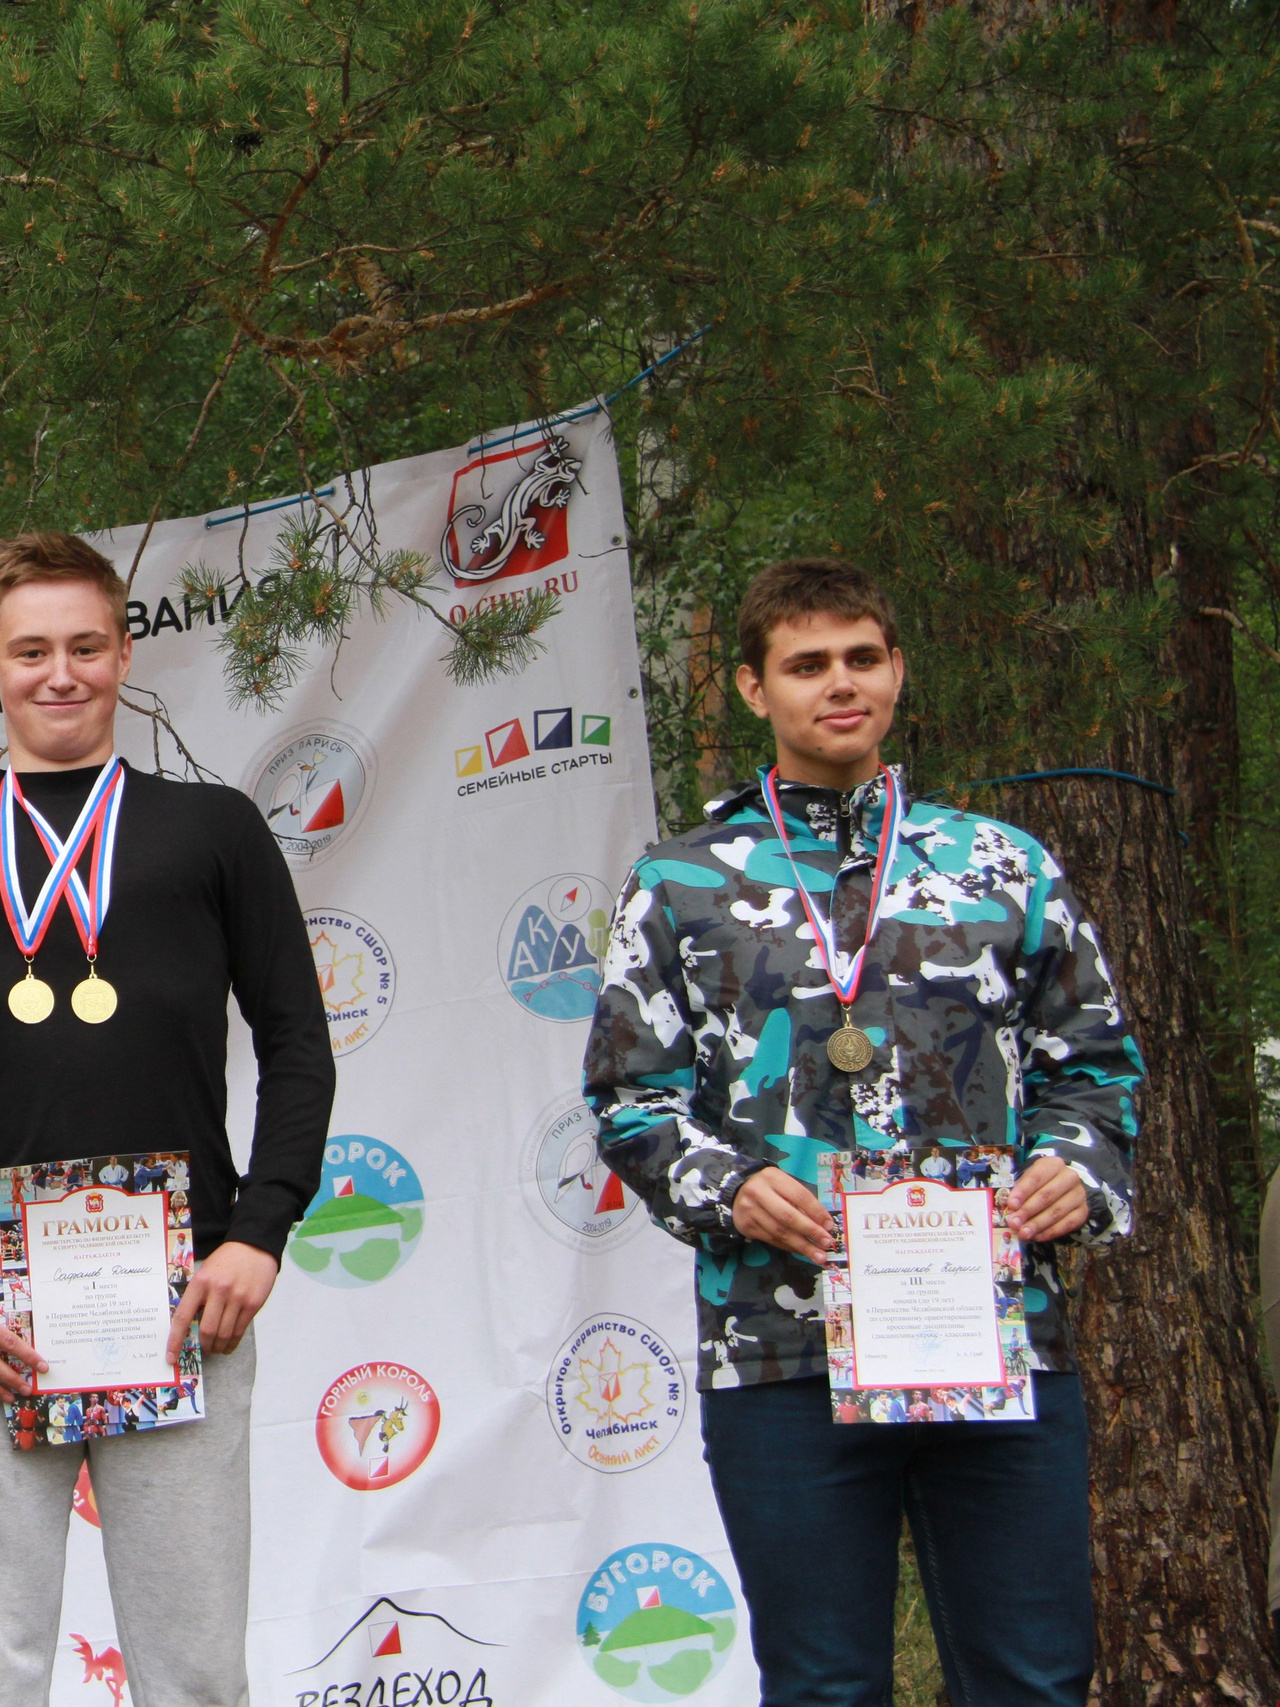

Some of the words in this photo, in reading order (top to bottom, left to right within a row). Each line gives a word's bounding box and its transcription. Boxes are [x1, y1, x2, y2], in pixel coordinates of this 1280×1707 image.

[269, 748, 295, 775] ПРИЗ
[299, 738, 345, 753] ЛАРИСЫ
[457, 766, 547, 797] СЕМЕЙНЫЕ
[551, 753, 613, 775] СТАРТЫ
[286, 835, 331, 851] 2004-2019
[355, 927, 387, 966] СШОР
[380, 972, 390, 989] №
[377, 996, 387, 1005] 5
[551, 1112, 582, 1139] ПРИЗ
[324, 1141, 407, 1188] ОРОК
[42, 1214, 149, 1237] ГРАМОТА
[862, 1210, 974, 1230] ГРАМОТА
[73, 1252, 121, 1260] НАГРАЖДАЕТСЯ
[909, 1277, 923, 1286] III
[51, 1311, 88, 1320] Первенстве
[90, 1308, 132, 1317] Челябинской
[871, 1306, 910, 1314] Первенстве
[923, 1313, 981, 1321] ориентированию
[58, 1319, 100, 1328] спортивному
[101, 1316, 156, 1325] ориентированию
[65, 1328, 100, 1336] кроссовые
[101, 1325, 140, 1334] дисциплины
[570, 1322, 636, 1355] первенство
[640, 1334, 676, 1376] СШОР
[320, 1364, 372, 1416] ГОРНЫЙ
[376, 1364, 432, 1402] КОРОЛЬ
[555, 1357, 572, 1435] Открытое
[668, 1383, 679, 1401] №
[666, 1407, 677, 1417] 5
[586, 1420, 658, 1439] Челябинск
[588, 1444, 632, 1466] Осенний
[634, 1435, 660, 1460] лист
[585, 1550, 716, 1613] БУГОРОК
